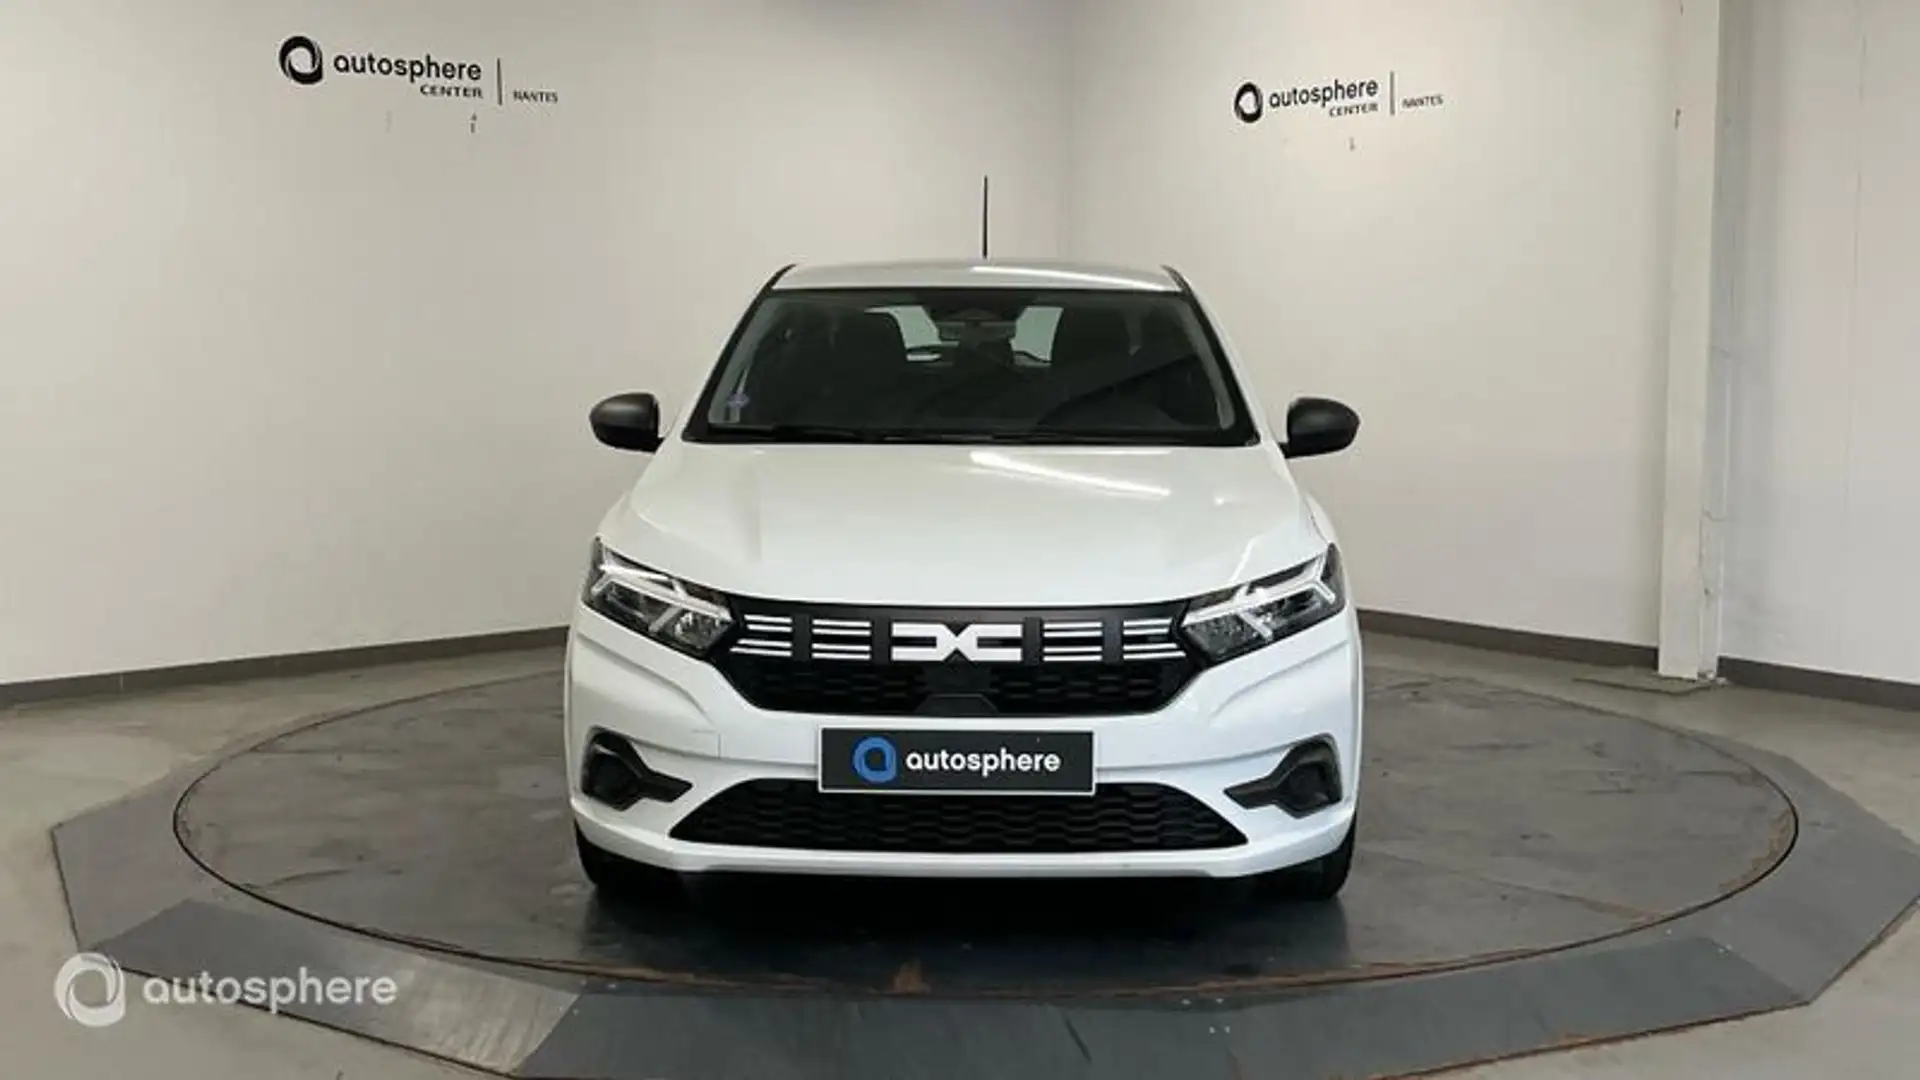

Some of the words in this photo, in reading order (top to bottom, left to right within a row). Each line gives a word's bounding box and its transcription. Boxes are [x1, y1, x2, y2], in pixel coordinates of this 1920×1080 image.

[333, 53, 482, 83] autosphere
[420, 84, 483, 98] CENTER
[1269, 79, 1379, 108] autosphere
[1329, 102, 1379, 117] CENTER
[906, 747, 1061, 777] autosphere
